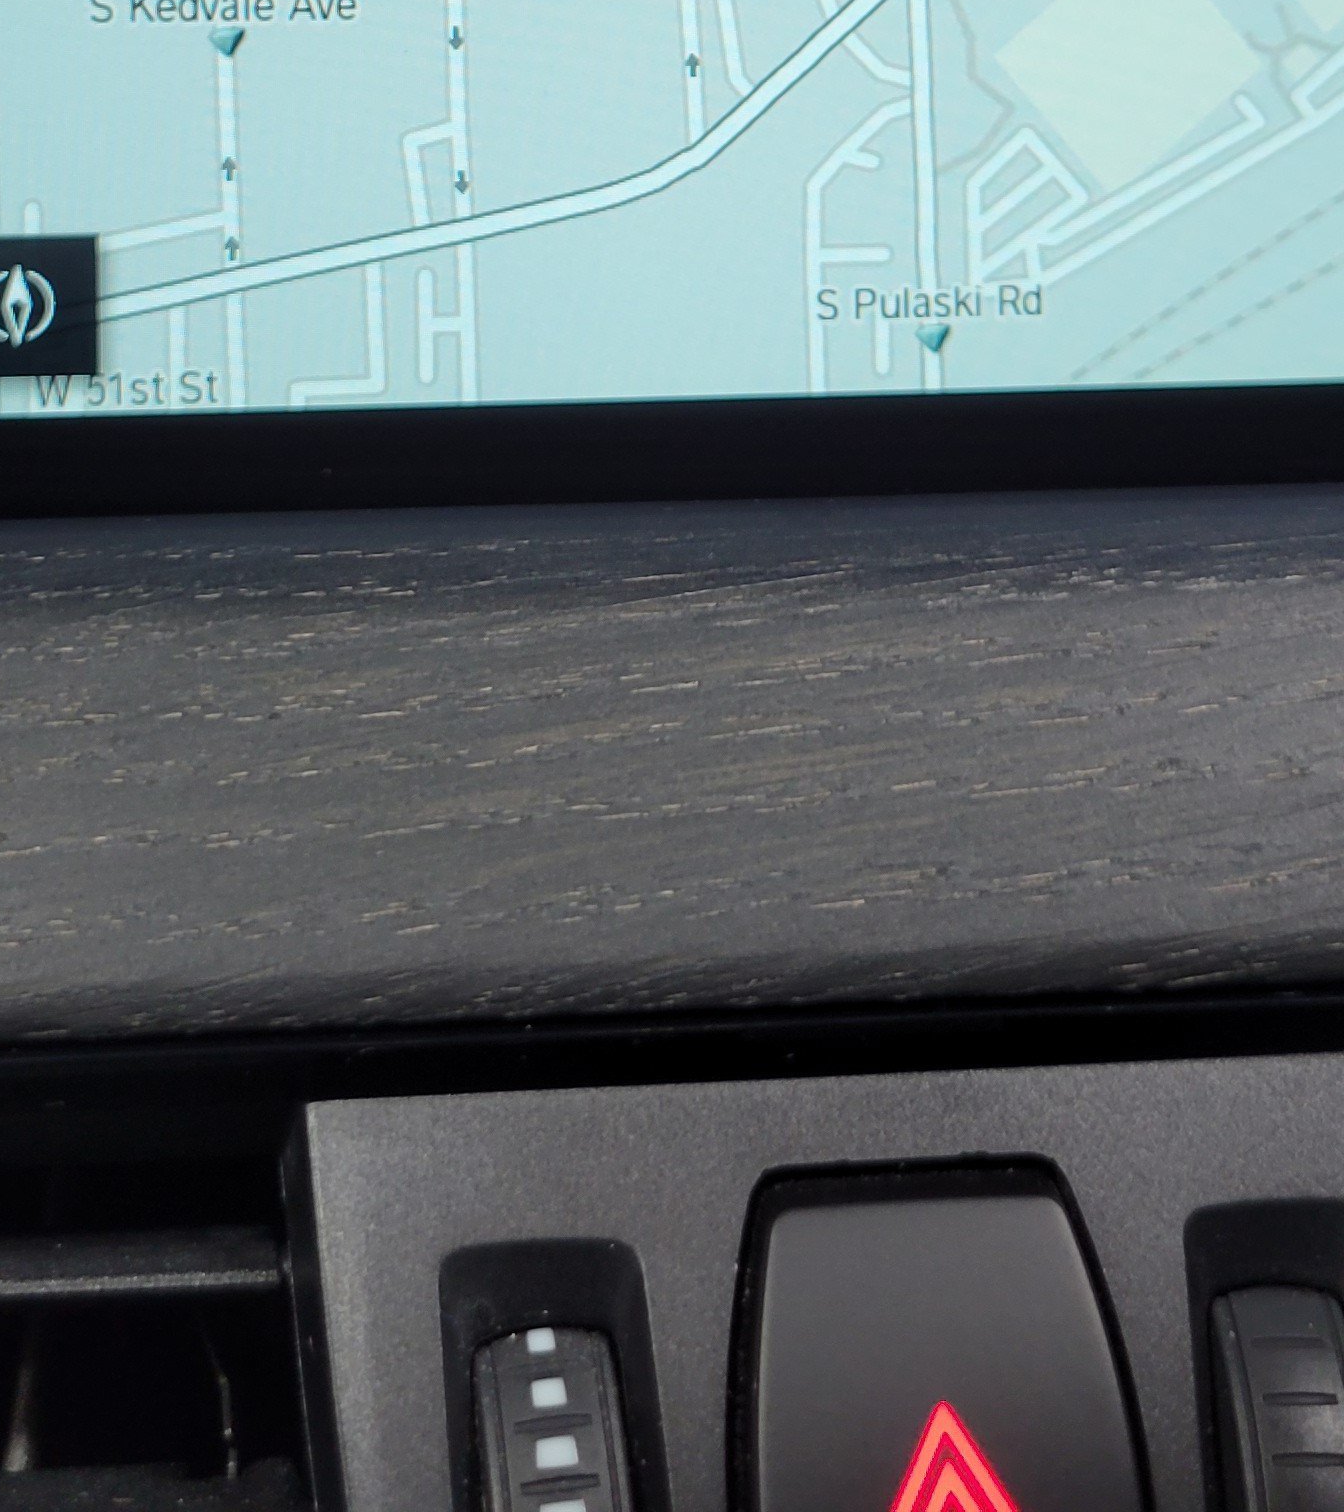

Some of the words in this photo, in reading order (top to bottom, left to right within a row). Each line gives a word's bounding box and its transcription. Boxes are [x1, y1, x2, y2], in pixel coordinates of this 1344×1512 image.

[816, 288, 839, 320] S
[854, 284, 982, 320] Pulaski
[997, 282, 1043, 316] Rd
[36, 375, 73, 408] W
[88, 371, 166, 406] 51st
[180, 369, 219, 405] St
